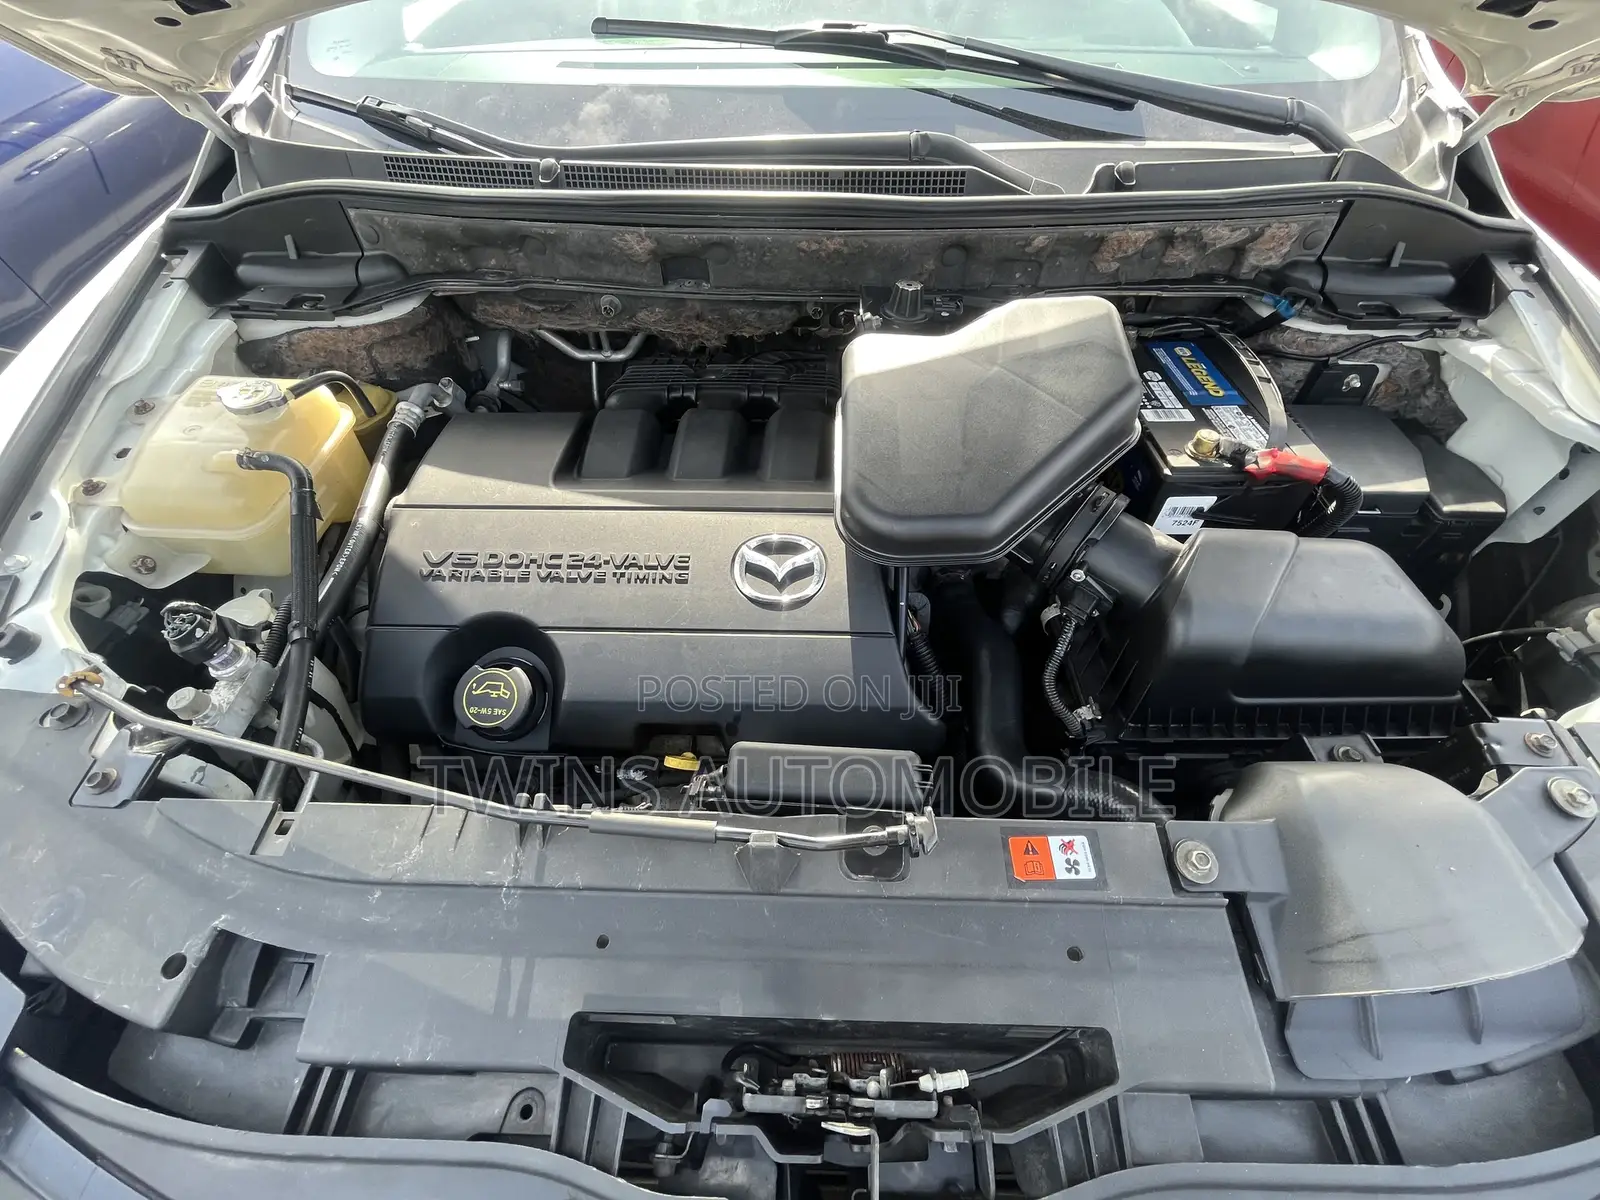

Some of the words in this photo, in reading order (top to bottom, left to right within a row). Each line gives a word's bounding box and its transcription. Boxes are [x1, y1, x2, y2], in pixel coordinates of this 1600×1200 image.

[1181, 356, 1225, 397] LEGEND
[423, 551, 479, 570] V6
[483, 551, 564, 570] DOHC
[567, 552, 691, 571] 24-VALVE
[419, 567, 531, 583] VARIABLE
[536, 568, 607, 584] VALVE
[612, 570, 690, 585] TIMING
[469, 706, 493, 715] 5W-20
[492, 708, 507, 716] SAE
